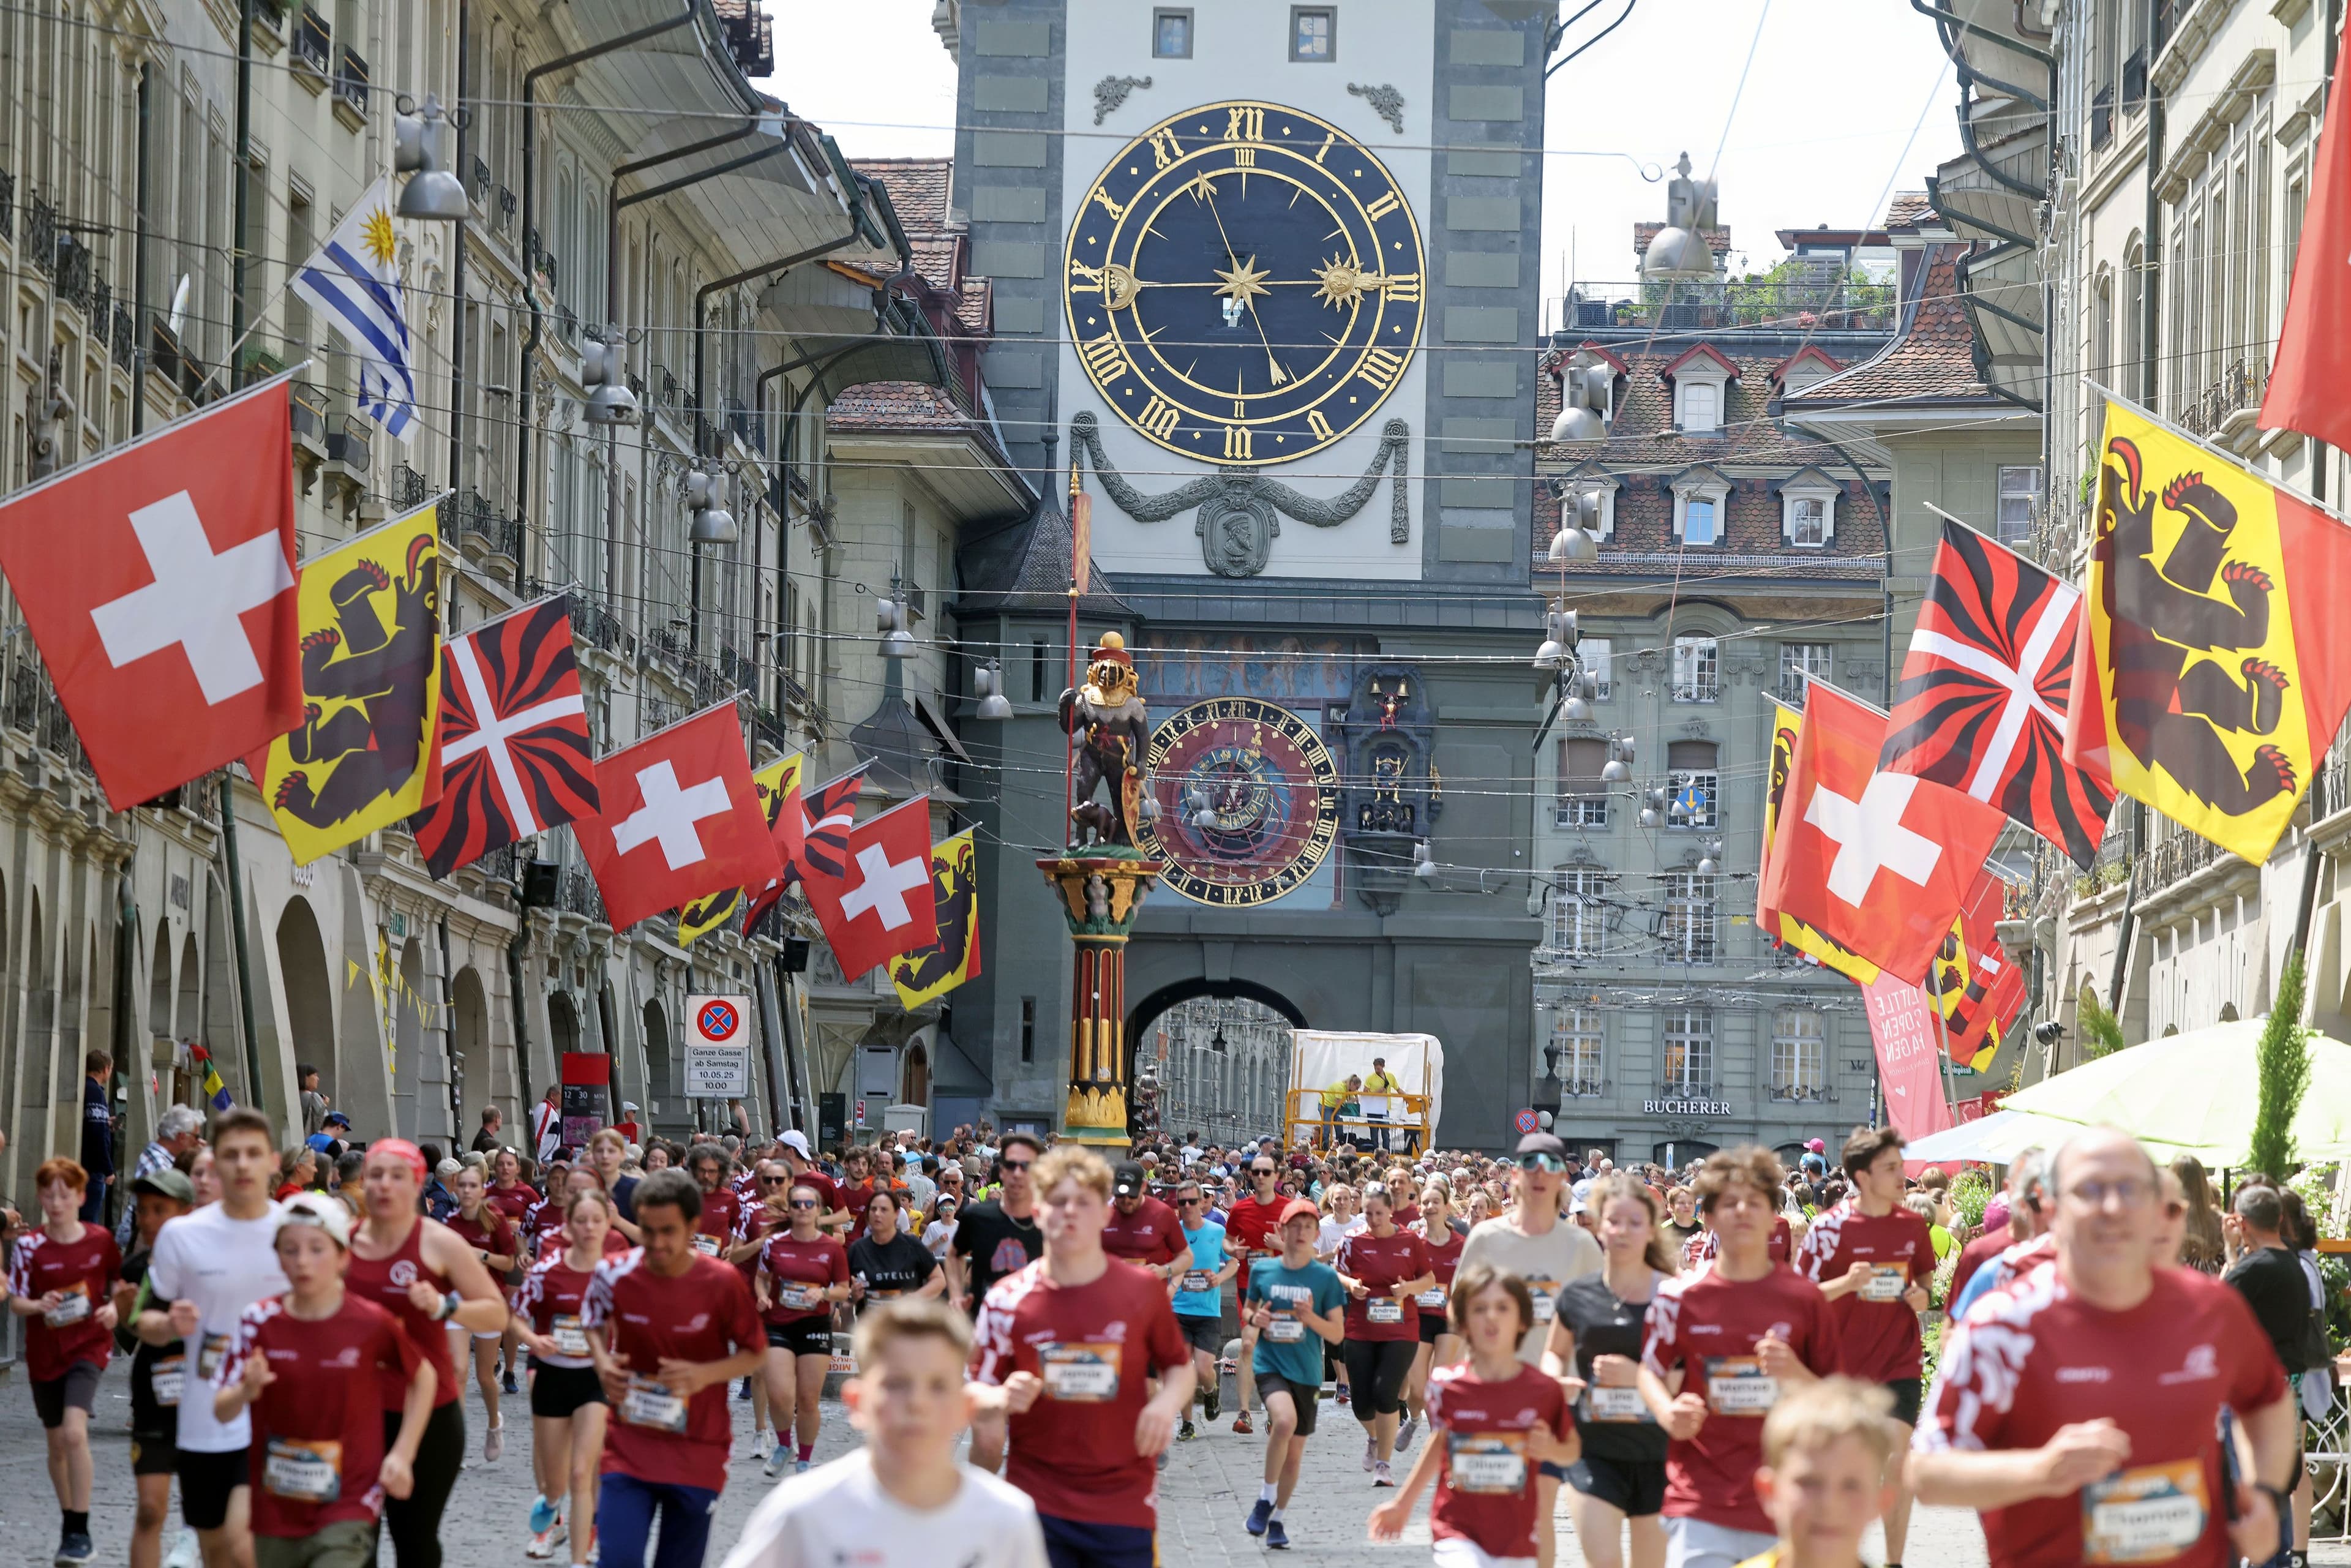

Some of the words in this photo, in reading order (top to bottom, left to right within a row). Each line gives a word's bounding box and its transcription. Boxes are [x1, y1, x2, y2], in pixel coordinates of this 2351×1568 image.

[1224, 106, 1265, 142] XII
[1148, 126, 1185, 170] XI
[1093, 186, 1124, 221] X
[1366, 189, 1400, 222] II
[1070, 258, 1105, 294] IX
[564, 1090, 572, 1099] 12
[578, 1090, 588, 1100] 30
[1643, 1100, 1731, 1116] BUCHERER
